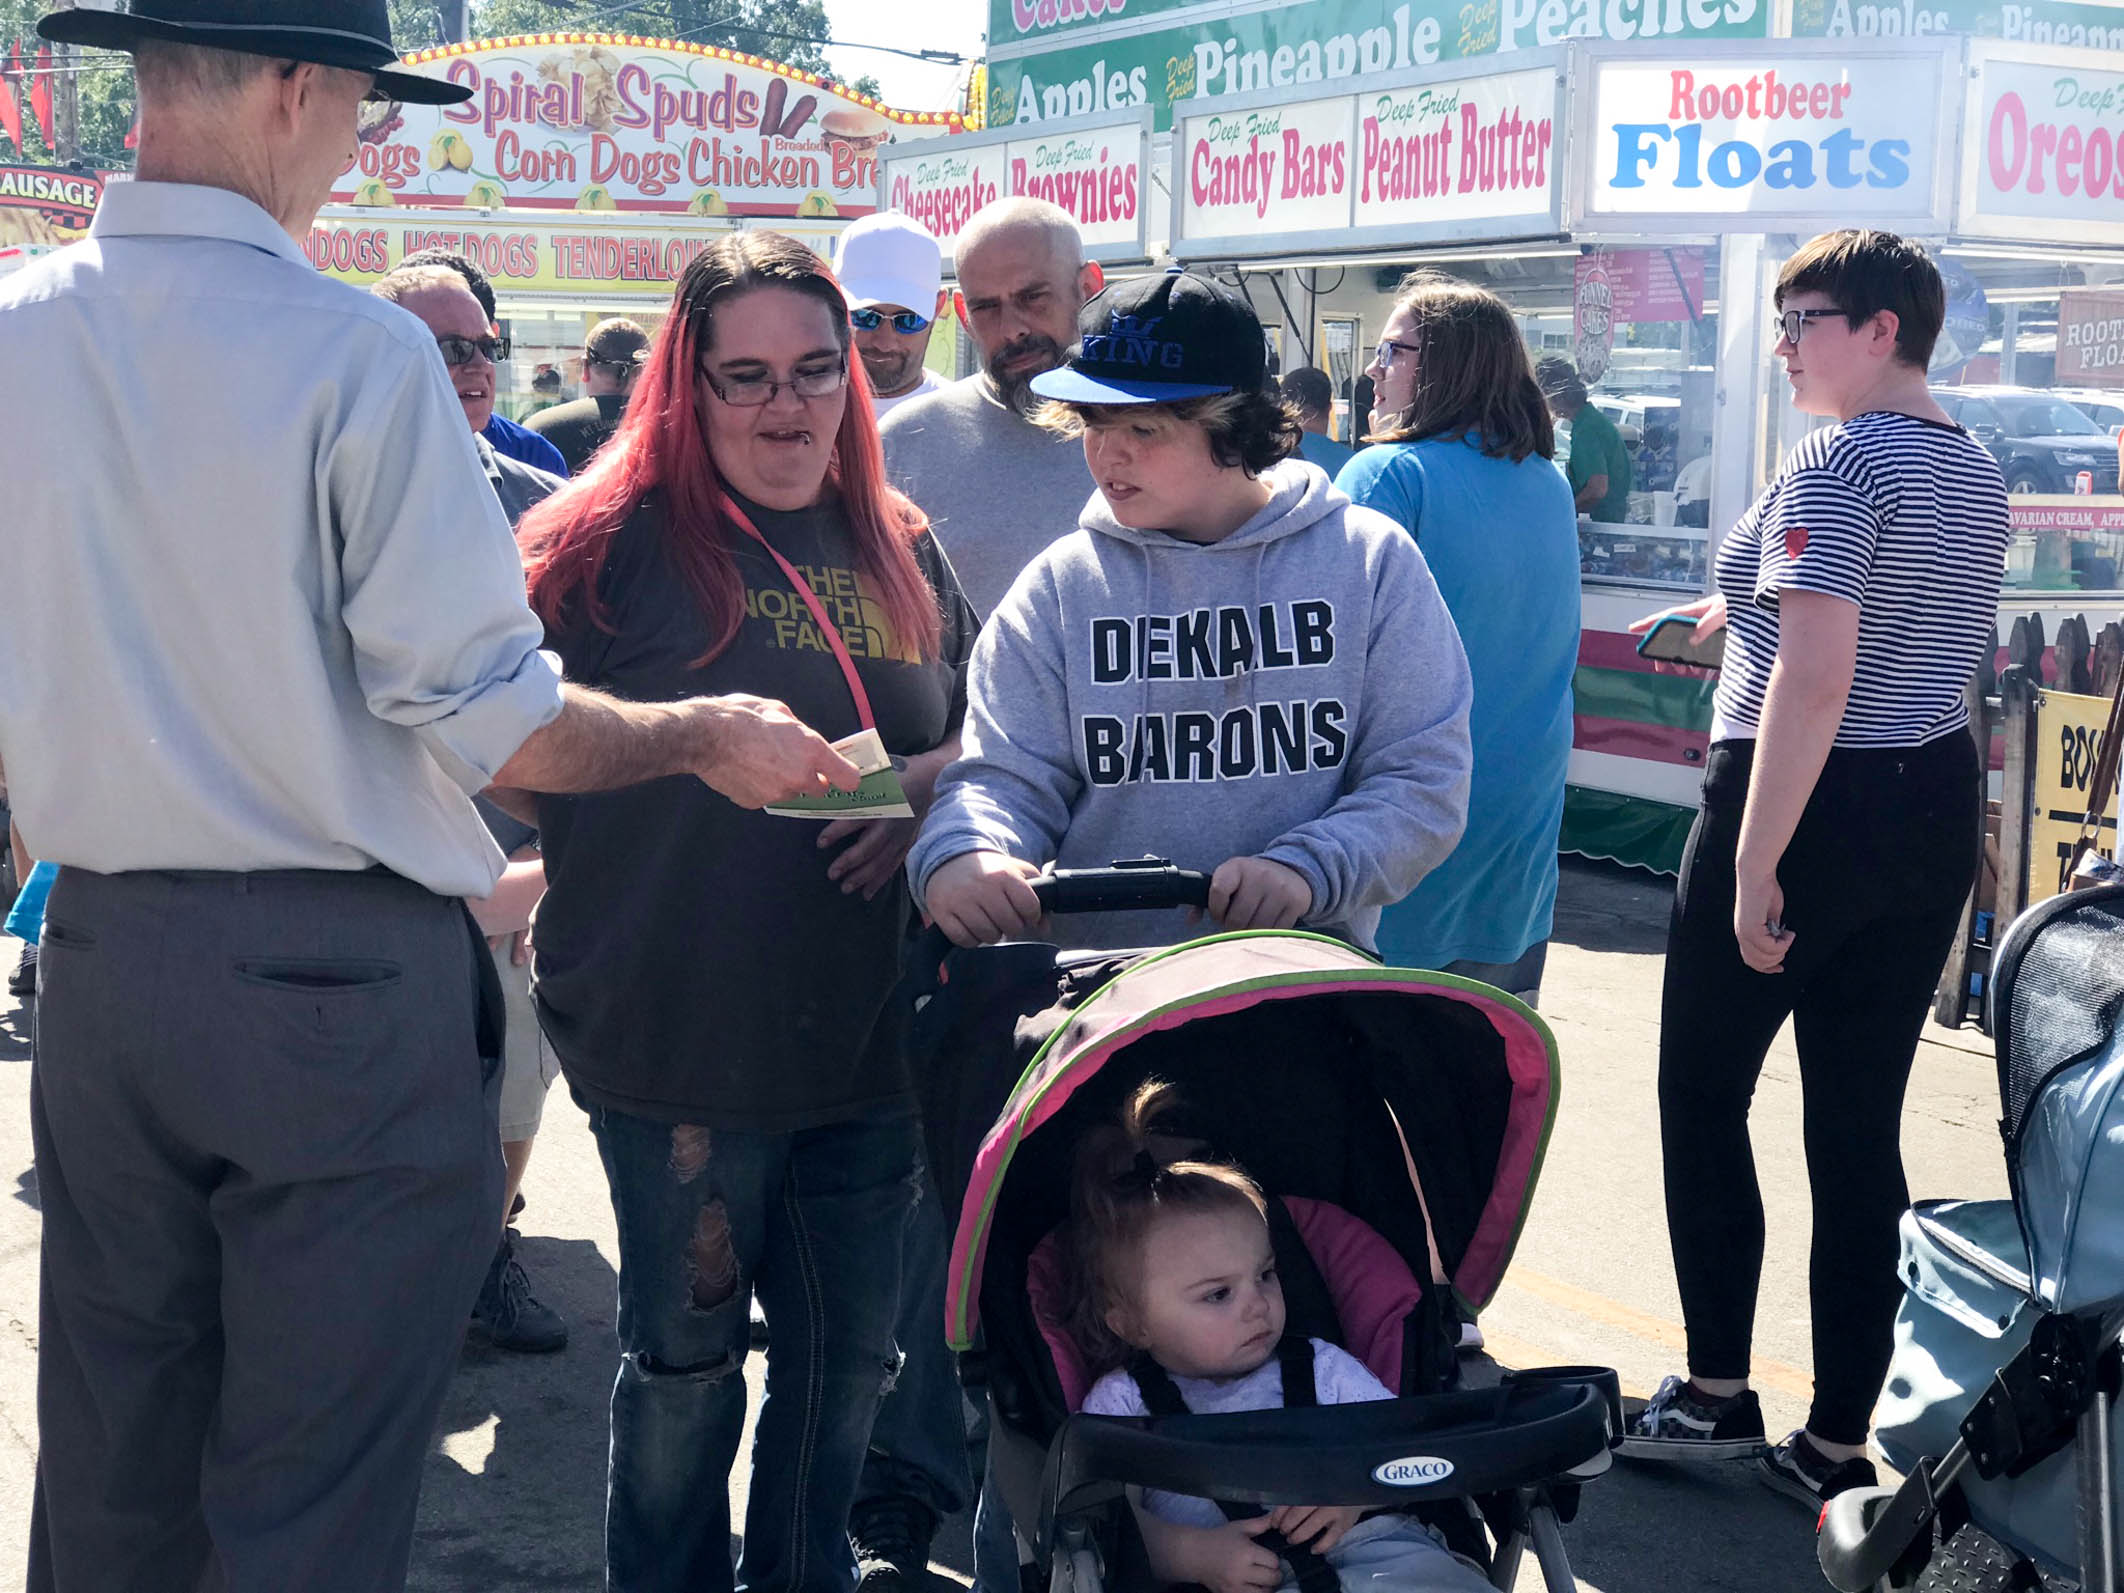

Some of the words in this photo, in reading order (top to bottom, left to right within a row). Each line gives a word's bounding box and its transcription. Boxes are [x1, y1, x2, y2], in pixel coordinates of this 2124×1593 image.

[1458, 0, 1497, 32] Deep
[1192, 5, 1441, 98] Pineapple
[1457, 26, 1497, 57] Fried
[1166, 53, 1195, 82] Deep
[444, 58, 585, 138] Spiral
[612, 63, 759, 143] Spuds
[1013, 60, 1147, 125] Apples
[1166, 75, 1195, 108] Fried
[1376, 94, 1415, 126] Deep
[1418, 88, 1460, 122] Fried
[1668, 70, 1851, 120] Rootbeer
[2053, 77, 2115, 117] Deep
[1208, 117, 1241, 146] Deep
[1246, 111, 1282, 143] Fried
[338, 142, 421, 189] ogs
[495, 129, 575, 182] Corn
[588, 133, 681, 195] Dogs
[687, 137, 819, 188] Chicken
[917, 163, 941, 186] Deep
[943, 158, 969, 183] Fried
[1036, 144, 1063, 170] Deep
[1064, 139, 1095, 166] Fried
[1361, 115, 1452, 204] Peanut
[1457, 102, 1551, 194] Butter
[1609, 123, 1912, 189] Floats
[0, 172, 97, 209] AUSAGE
[1191, 135, 1276, 219] Candy
[1281, 128, 1345, 200] Bars
[464, 232, 539, 278] DOGS
[552, 235, 710, 281] TENDERLOI
[1579, 281, 1612, 309] FUNNEL
[1081, 334, 1184, 369] KING
[2065, 320, 2124, 346] ROOT
[1090, 598, 1335, 686] DEKALB
[1082, 698, 1347, 788] BARONS
[1383, 1462, 1447, 1480] GRACO
